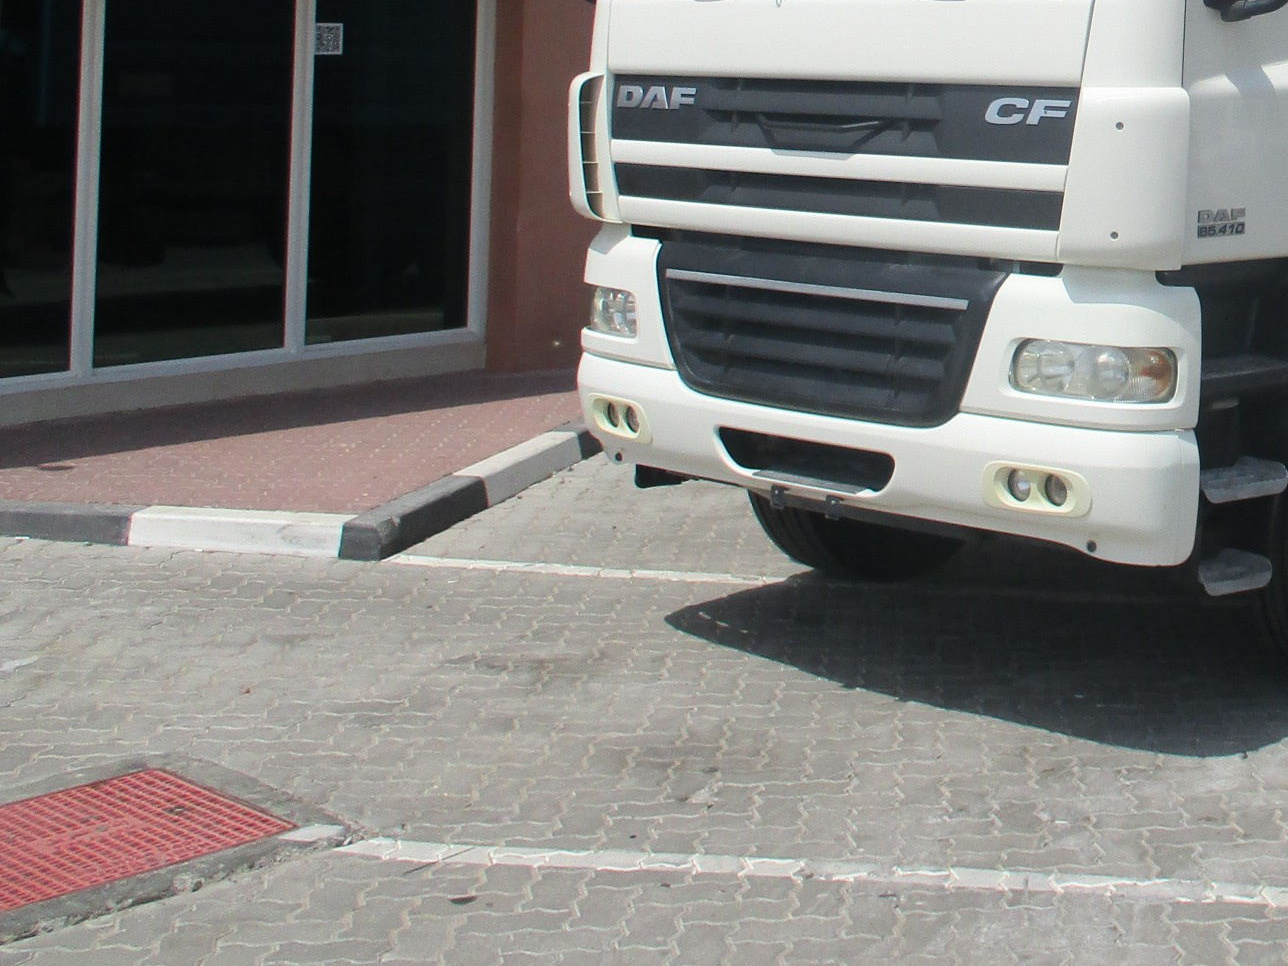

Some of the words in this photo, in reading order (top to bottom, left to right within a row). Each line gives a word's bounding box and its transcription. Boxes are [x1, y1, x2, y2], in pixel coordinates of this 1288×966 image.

[616, 85, 697, 110] DAF
[984, 97, 1072, 125] CF
[1198, 207, 1246, 223] DAF
